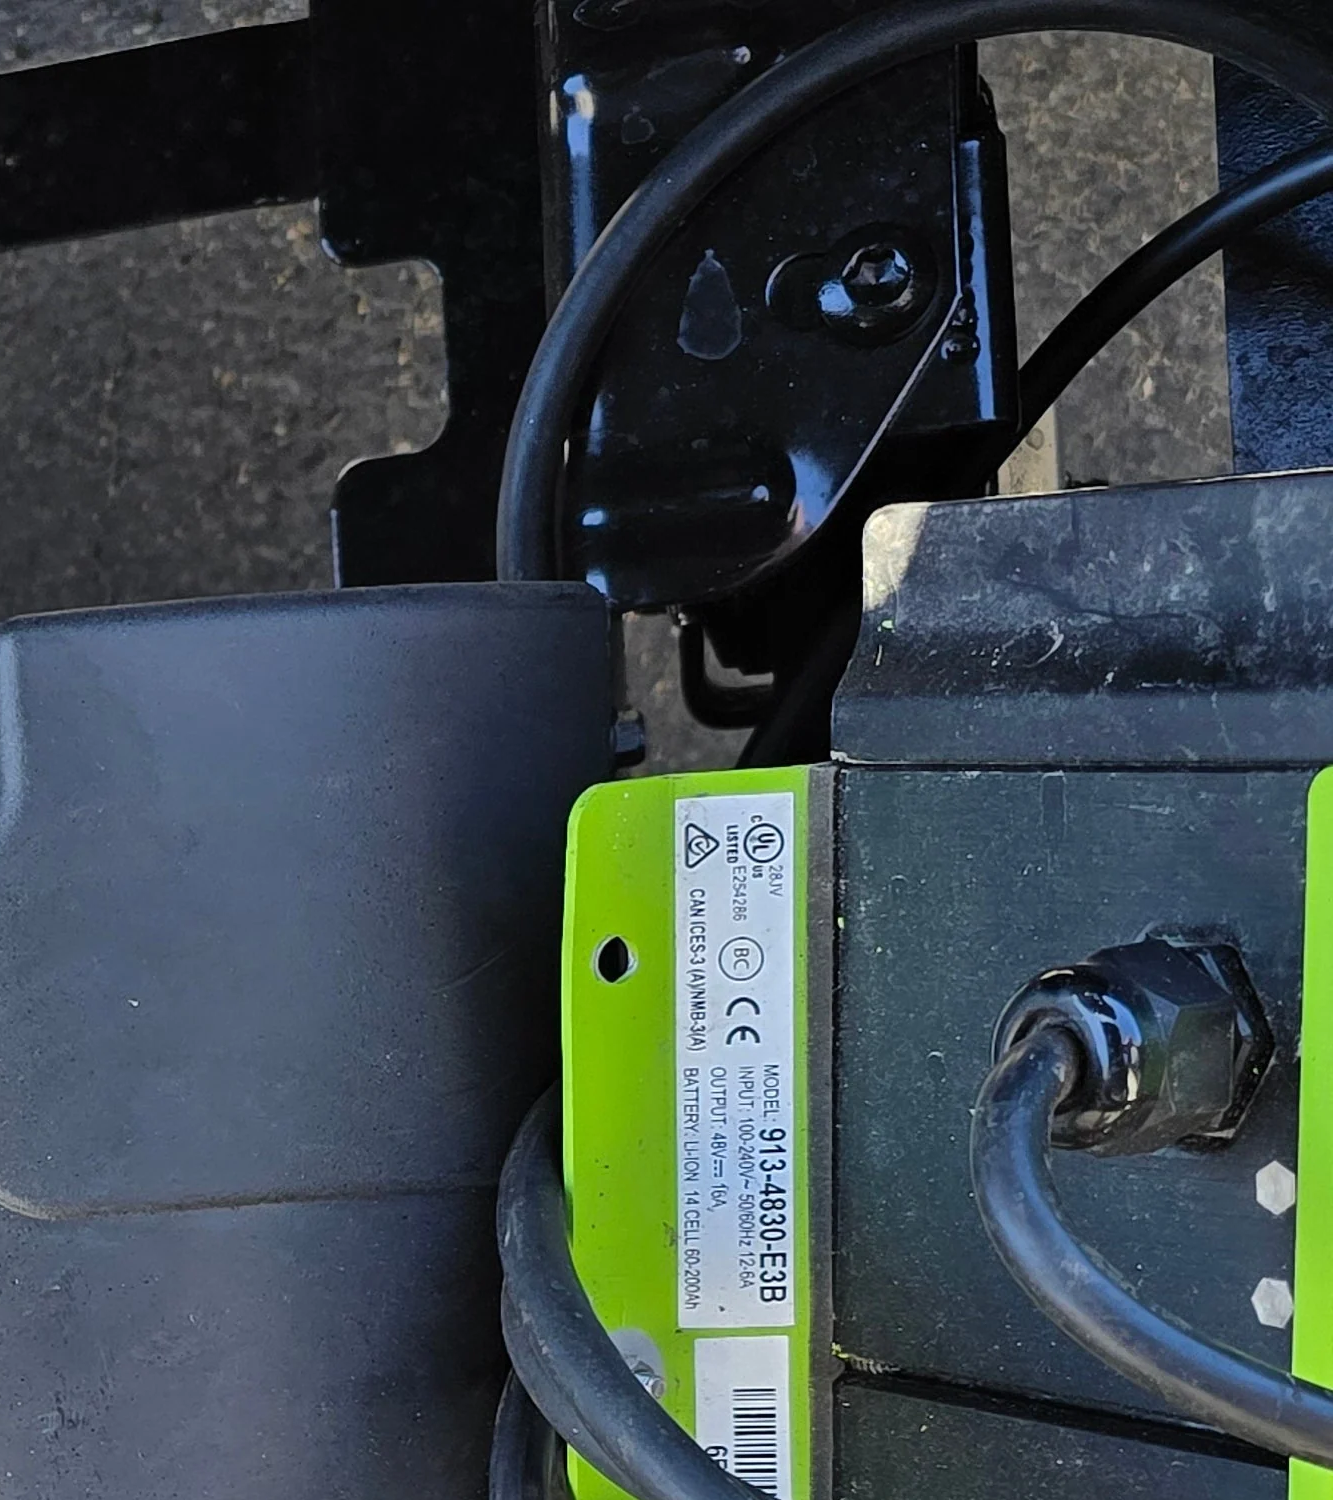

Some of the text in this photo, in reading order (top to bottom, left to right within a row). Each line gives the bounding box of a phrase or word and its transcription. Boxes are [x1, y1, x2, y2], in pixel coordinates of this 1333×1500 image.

[725, 824, 739, 863] LISTED
[687, 887, 705, 918] CAN
[731, 865, 746, 922] E254286
[768, 864, 783, 897] 28JV
[688, 920, 705, 965] ICES-3
[732, 946, 749, 971] BC
[725, 995, 760, 1045] CE
[709, 1065, 726, 1129] OUTPUT:
[737, 1065, 754, 1112] INPUT:
[682, 1066, 700, 1309] BATTERY: LI-ION 14 CELL 60-200Ah
[757, 1063, 787, 1303] MODEL: 913-4830-E3B
[737, 1193, 755, 1247] 50/60Hz
